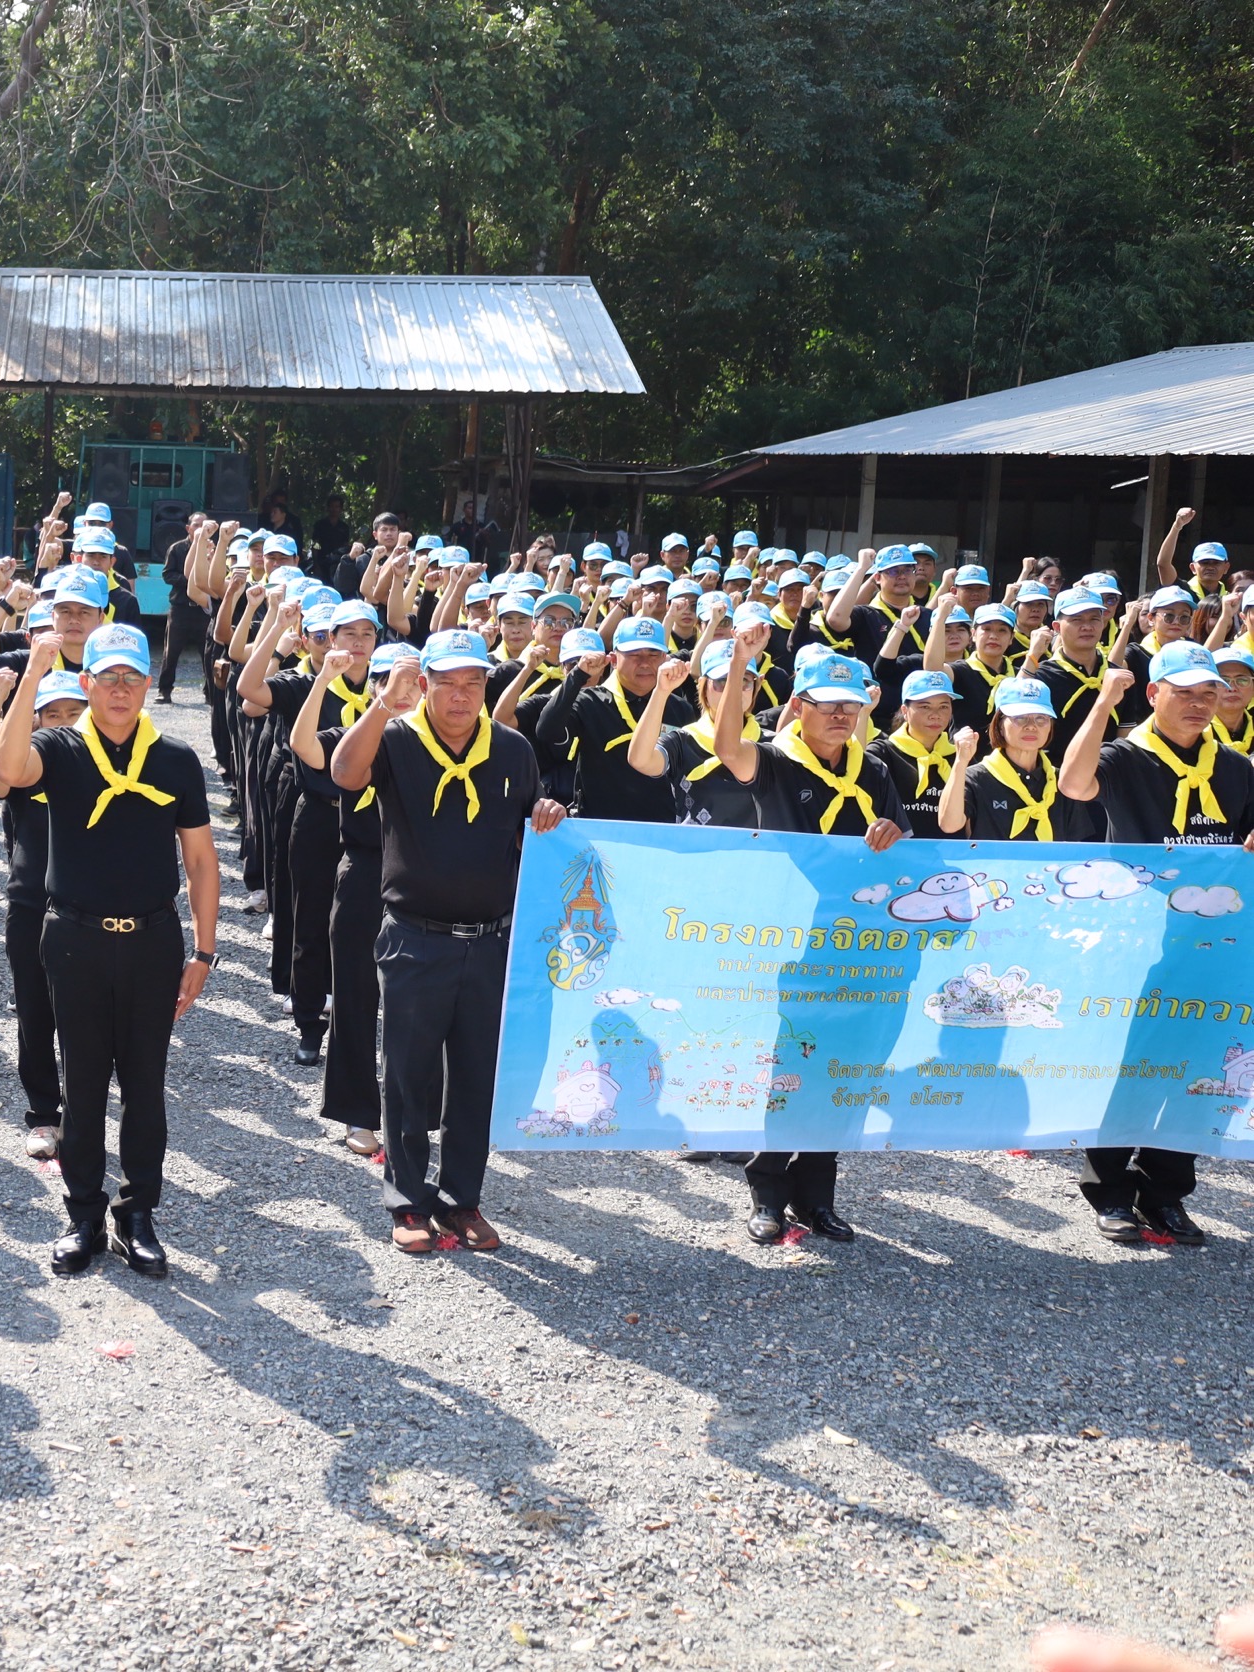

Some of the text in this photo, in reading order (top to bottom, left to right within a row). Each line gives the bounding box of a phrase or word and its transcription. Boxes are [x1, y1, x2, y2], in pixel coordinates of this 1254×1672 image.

[662, 906, 978, 951] โครงการจิตอาสา
[717, 953, 904, 979] หน่วยพระราชทาน
[695, 981, 912, 1004] และประชาชนจิตอาสา
[1078, 988, 1254, 1025] เราทำควา
[827, 1054, 1189, 1080] จิตอาสา พัฒนาสถานที่สาธารณประโยชน์
[831, 1085, 964, 1107] จังหวัด ยโสธร
